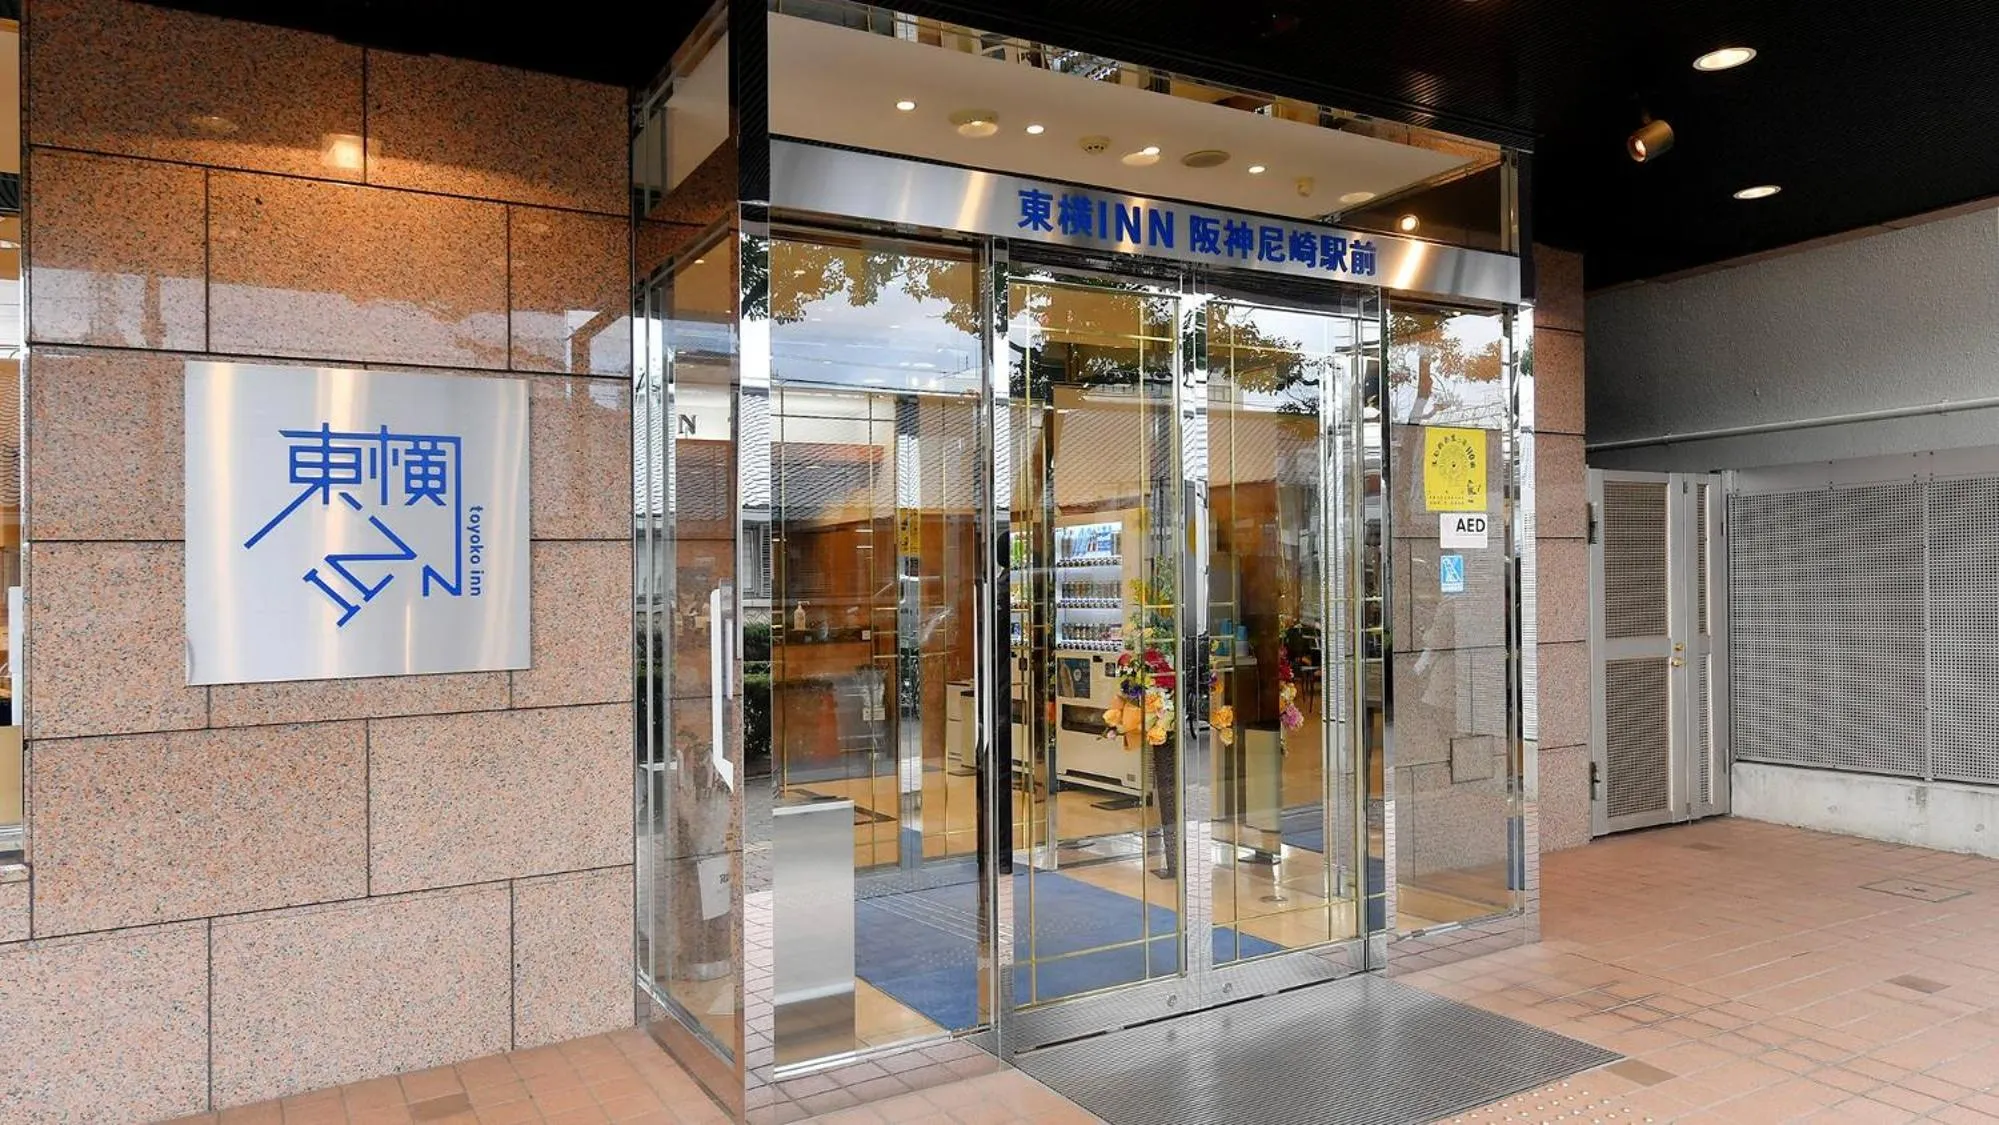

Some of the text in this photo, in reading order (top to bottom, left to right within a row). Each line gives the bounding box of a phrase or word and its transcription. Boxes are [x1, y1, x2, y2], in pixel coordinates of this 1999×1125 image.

[1017, 188, 1377, 276] 東横INN 阪神尼崎駅前
[467, 505, 484, 597] toyoko inn
[1456, 518, 1486, 532] AED
